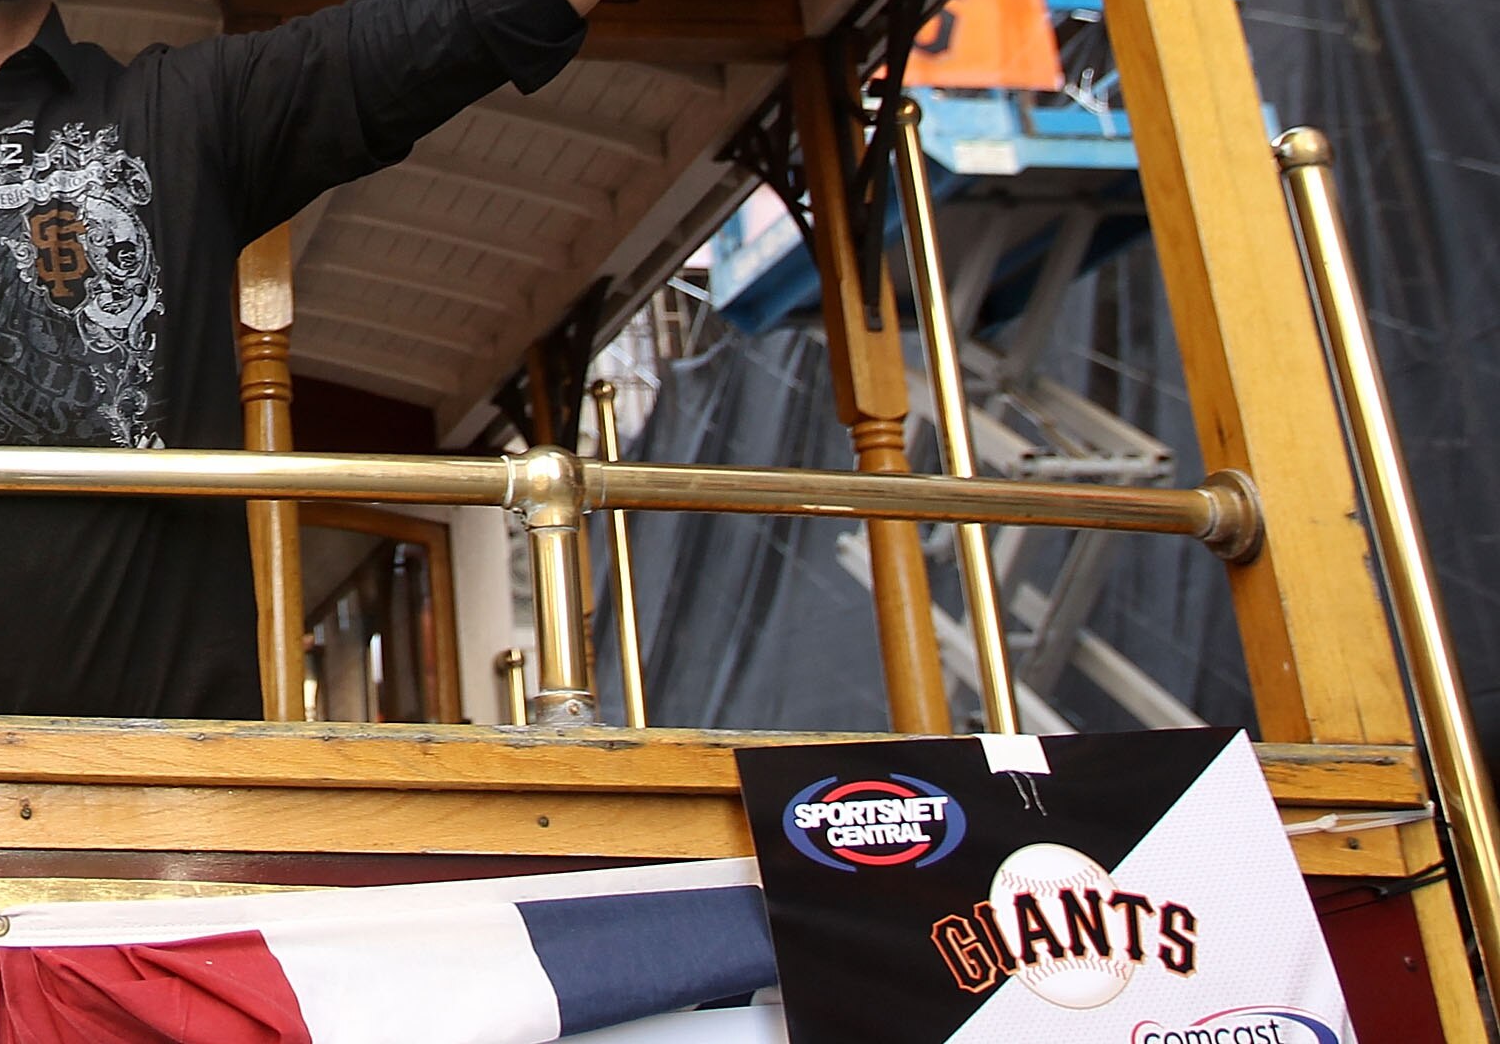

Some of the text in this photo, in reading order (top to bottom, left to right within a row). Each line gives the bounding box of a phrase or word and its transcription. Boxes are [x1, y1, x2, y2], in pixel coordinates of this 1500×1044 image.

[30, 209, 88, 298] SF
[794, 796, 949, 829] SPORTSNET
[826, 822, 932, 848] CENTRAL
[930, 887, 1198, 994] GIANTS
[1143, 1019, 1285, 1044] comcast
